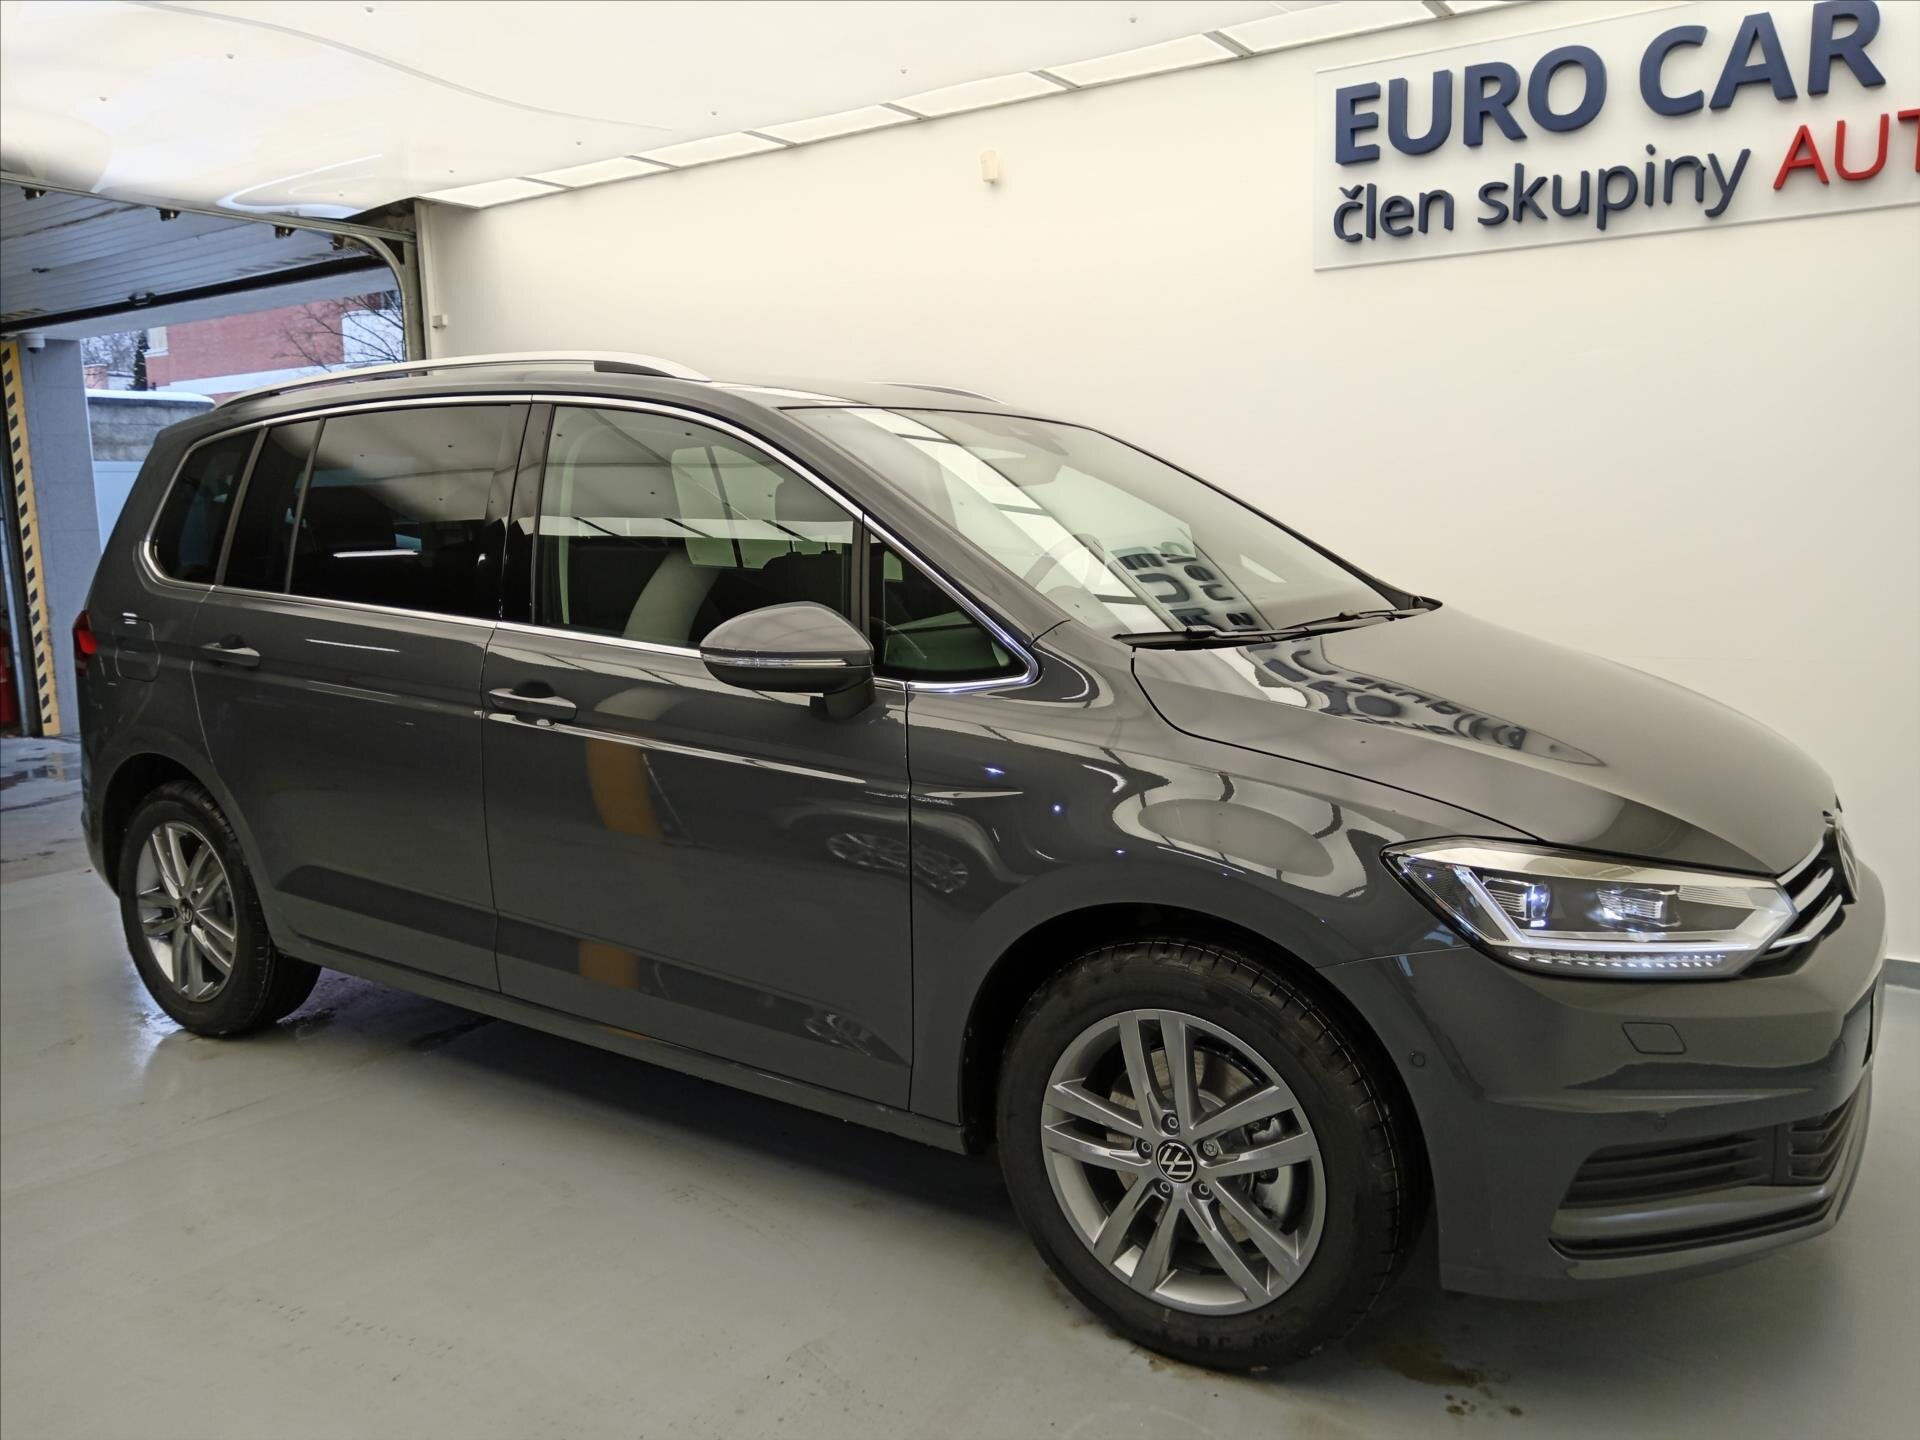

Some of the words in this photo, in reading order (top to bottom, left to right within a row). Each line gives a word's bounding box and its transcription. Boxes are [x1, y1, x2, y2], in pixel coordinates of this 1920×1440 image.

[1335, 45, 1607, 167] EURO
[1639, 0, 1887, 118] CAR
[1333, 184, 1455, 244] člen
[1477, 144, 1752, 232] skupiny
